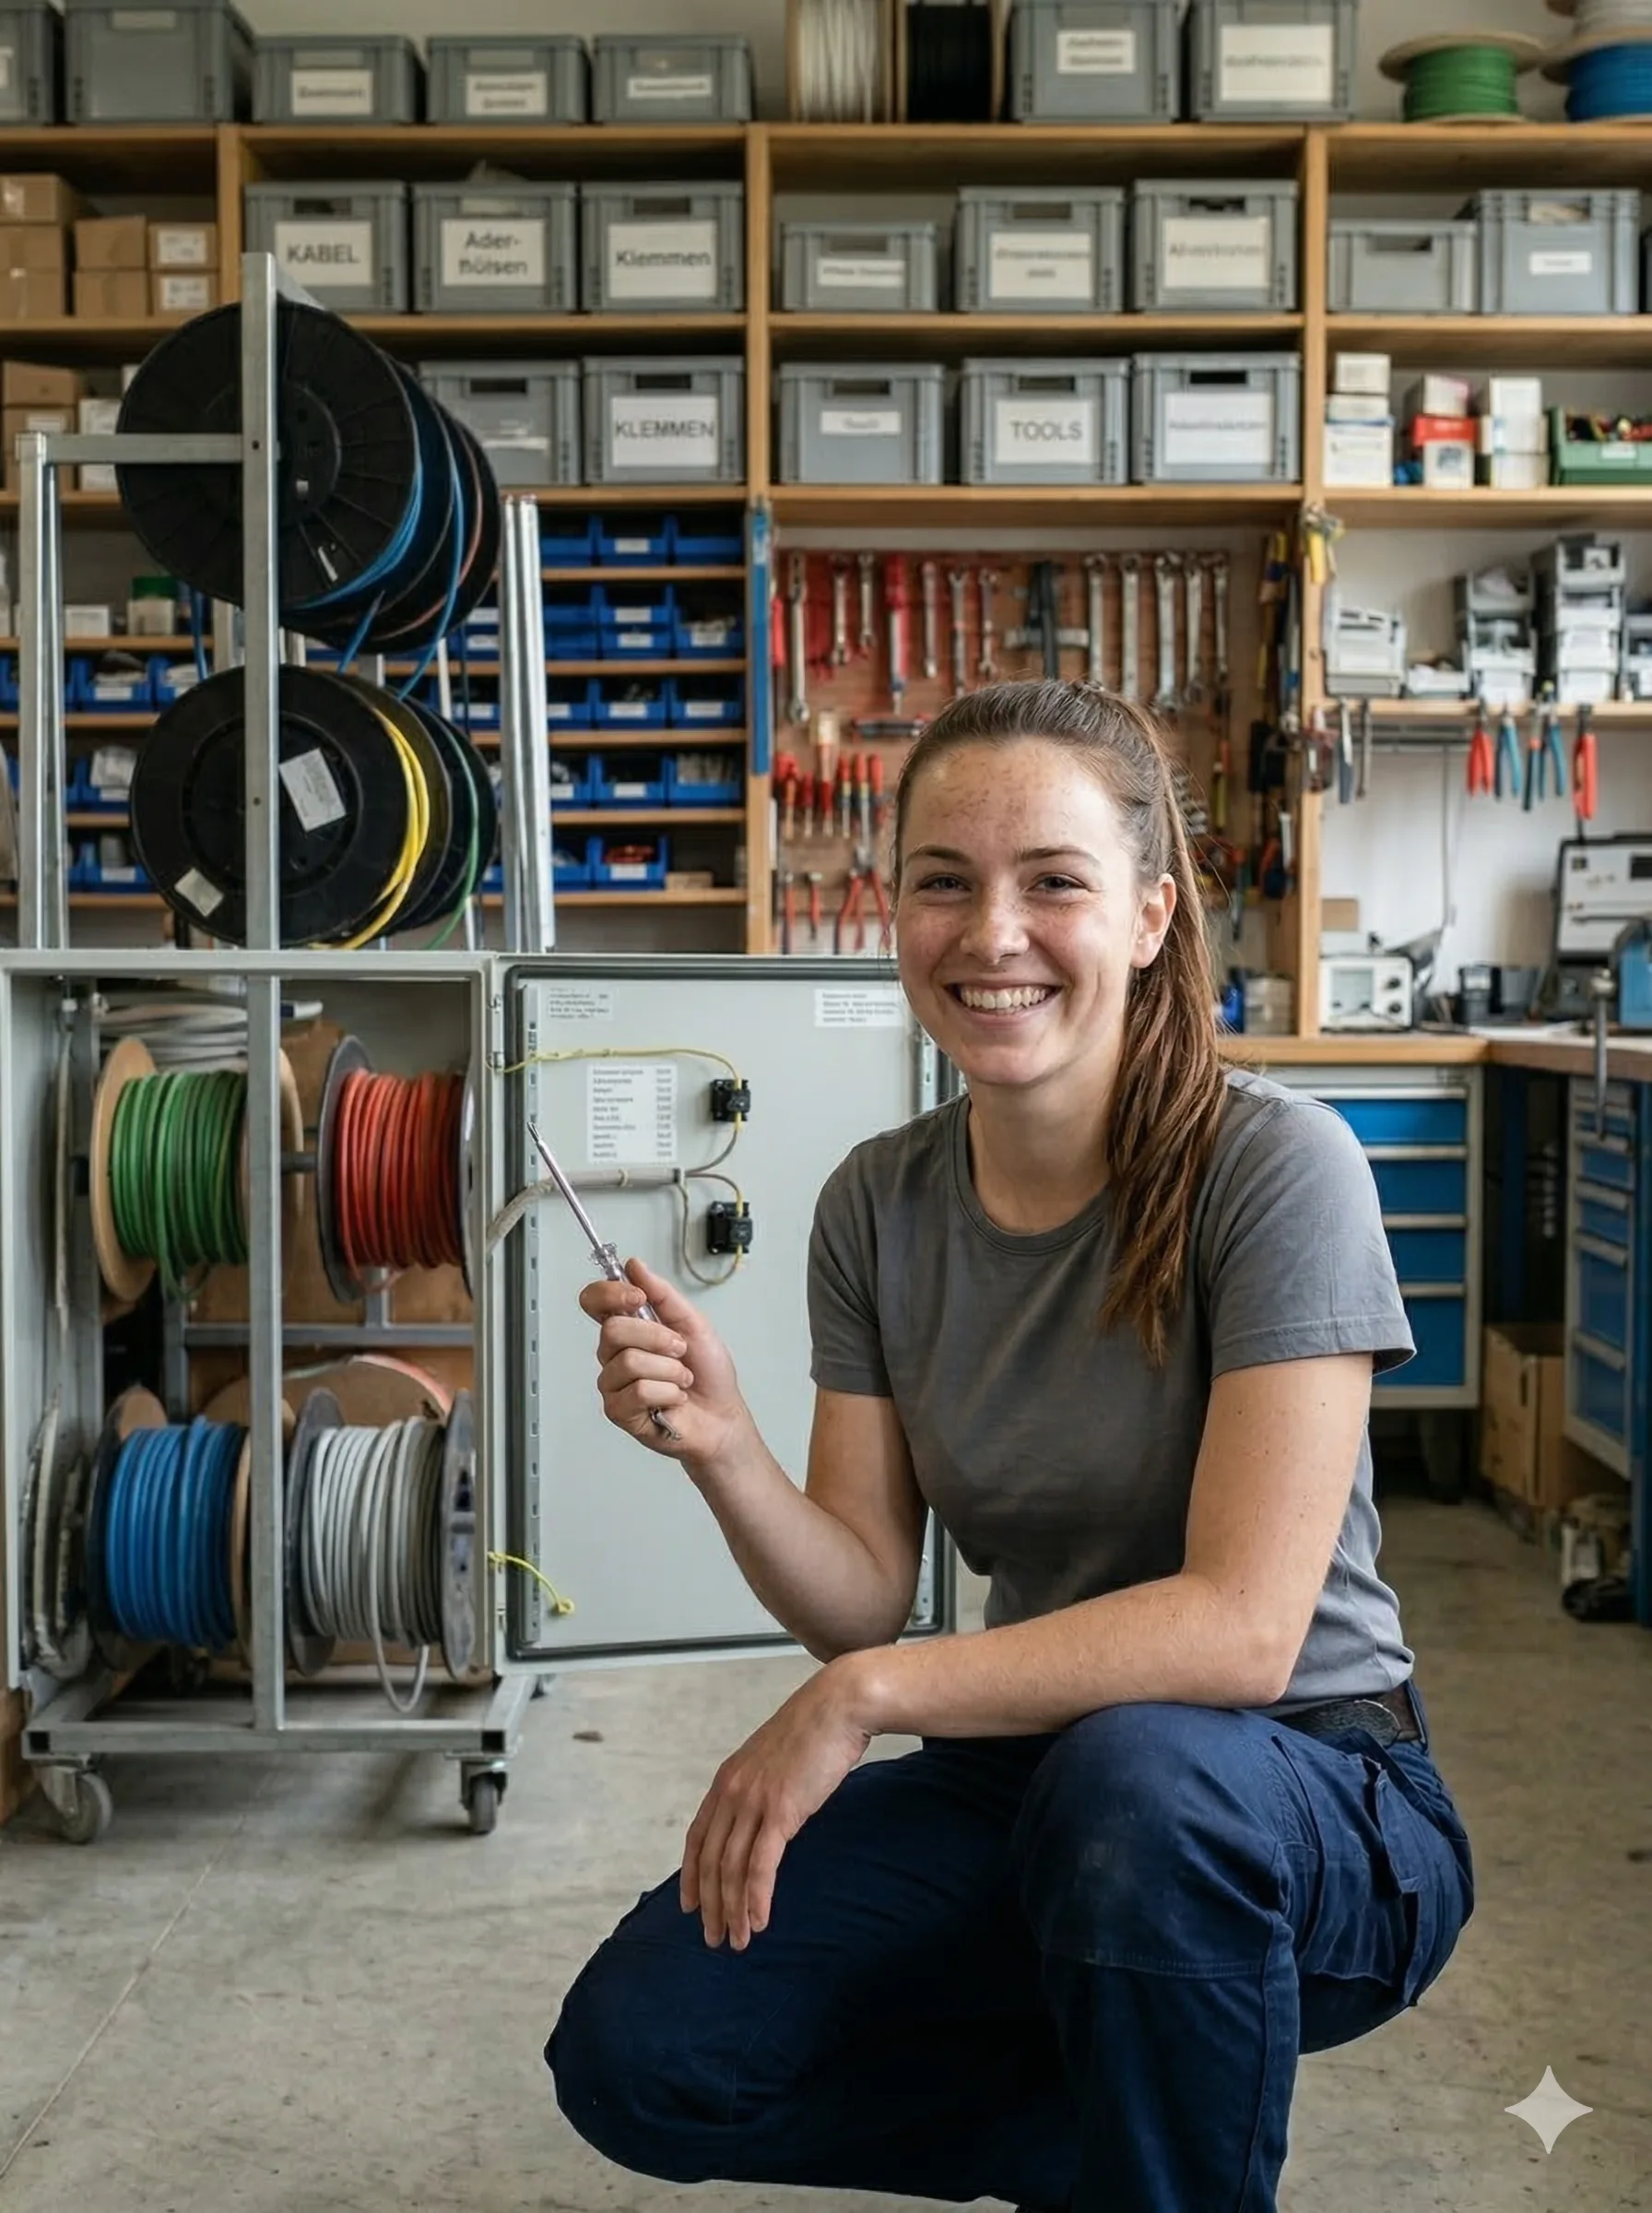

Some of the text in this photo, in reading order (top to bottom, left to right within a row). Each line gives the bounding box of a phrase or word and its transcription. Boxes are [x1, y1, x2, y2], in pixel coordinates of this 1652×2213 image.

[464, 230, 523, 251] Ader-
[286, 243, 360, 265] KABEL
[615, 419, 715, 440] KLEMMEN
[1009, 420, 1083, 442] TOOLS
